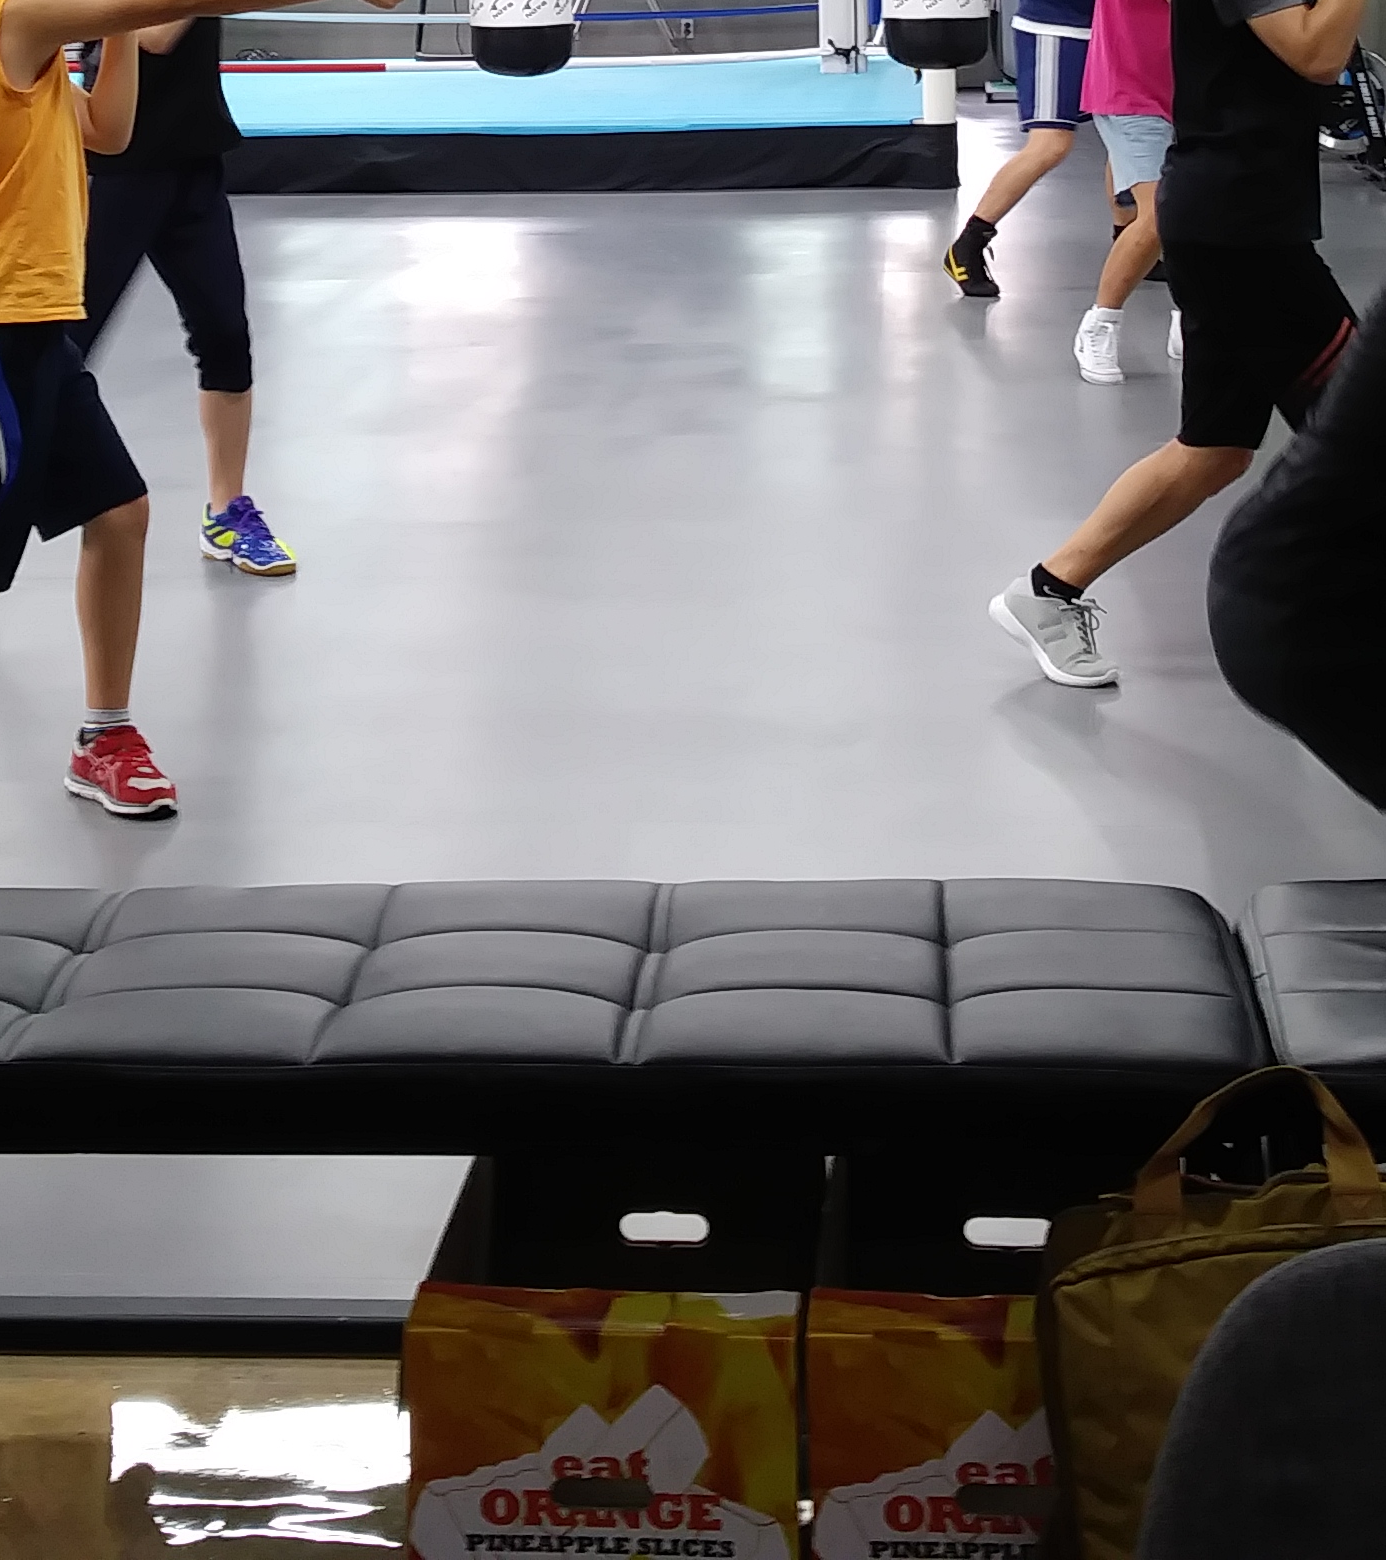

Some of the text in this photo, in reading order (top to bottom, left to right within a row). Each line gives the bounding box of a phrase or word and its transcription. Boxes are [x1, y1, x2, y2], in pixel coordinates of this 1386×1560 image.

[552, 1449, 649, 1480] eat
[464, 1533, 735, 1558] PINEAPPLE SLICES
